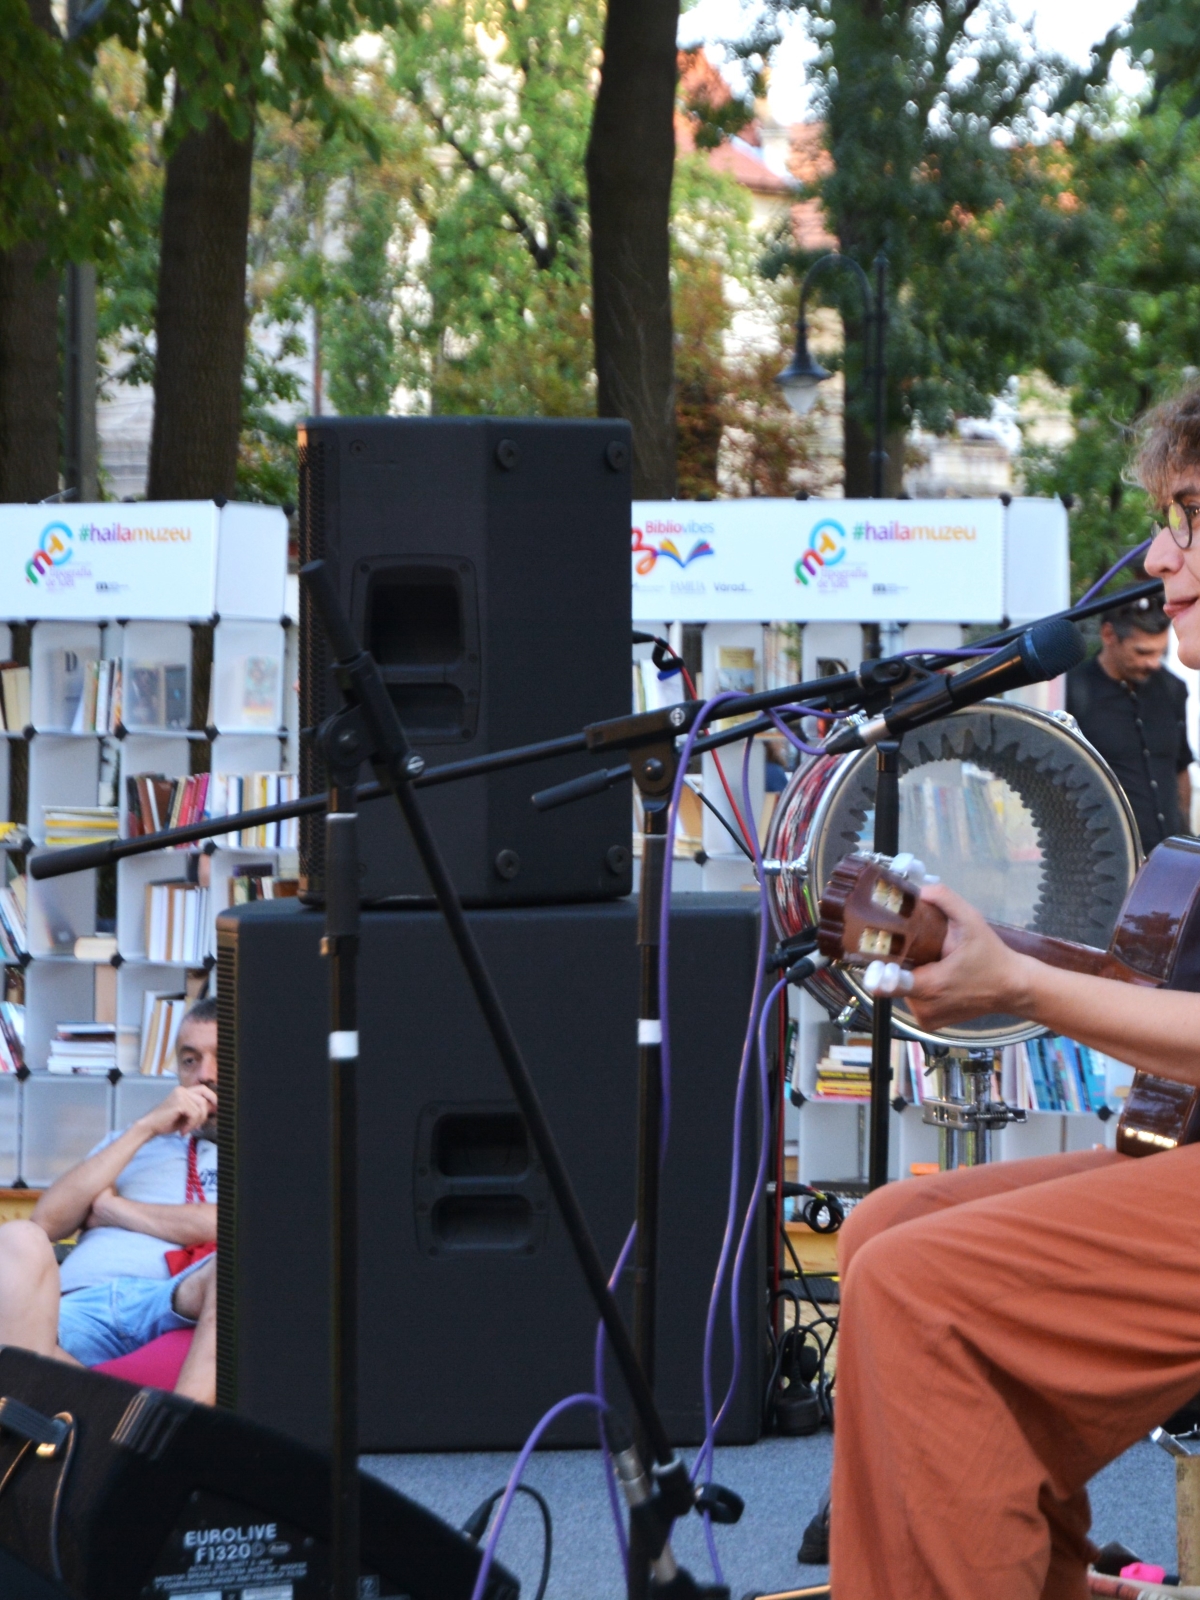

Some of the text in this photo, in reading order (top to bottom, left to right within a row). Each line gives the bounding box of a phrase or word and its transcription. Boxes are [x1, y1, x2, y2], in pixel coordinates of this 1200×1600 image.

[78, 523, 192, 543] #hailamuzeu
[645, 519, 715, 535] Bibliovibes
[852, 520, 977, 541] #hailamuzeu
[184, 1522, 277, 1547] EUROLIVE
